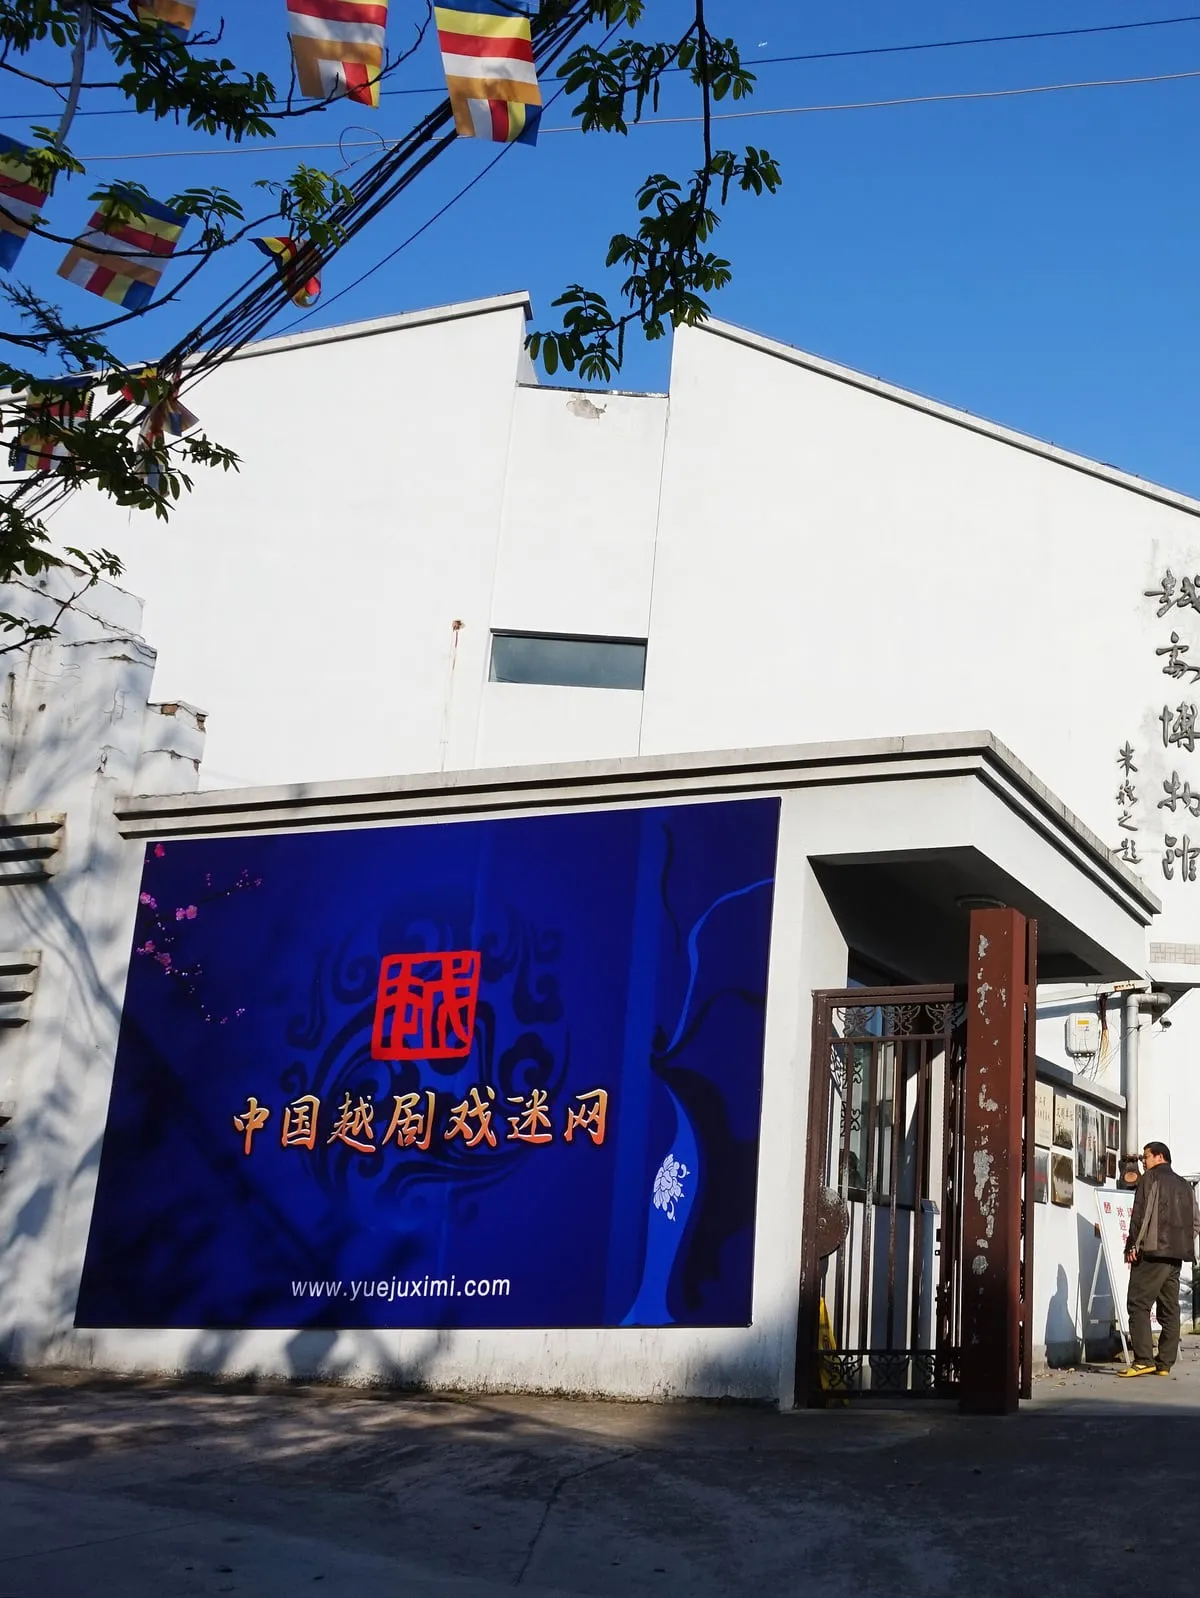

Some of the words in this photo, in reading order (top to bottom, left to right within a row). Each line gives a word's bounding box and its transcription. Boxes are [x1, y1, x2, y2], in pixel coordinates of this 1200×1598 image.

[232, 1087, 608, 1155] 中国越剧戏迷网
[290, 1273, 511, 1301] www.yuejuximi.com
